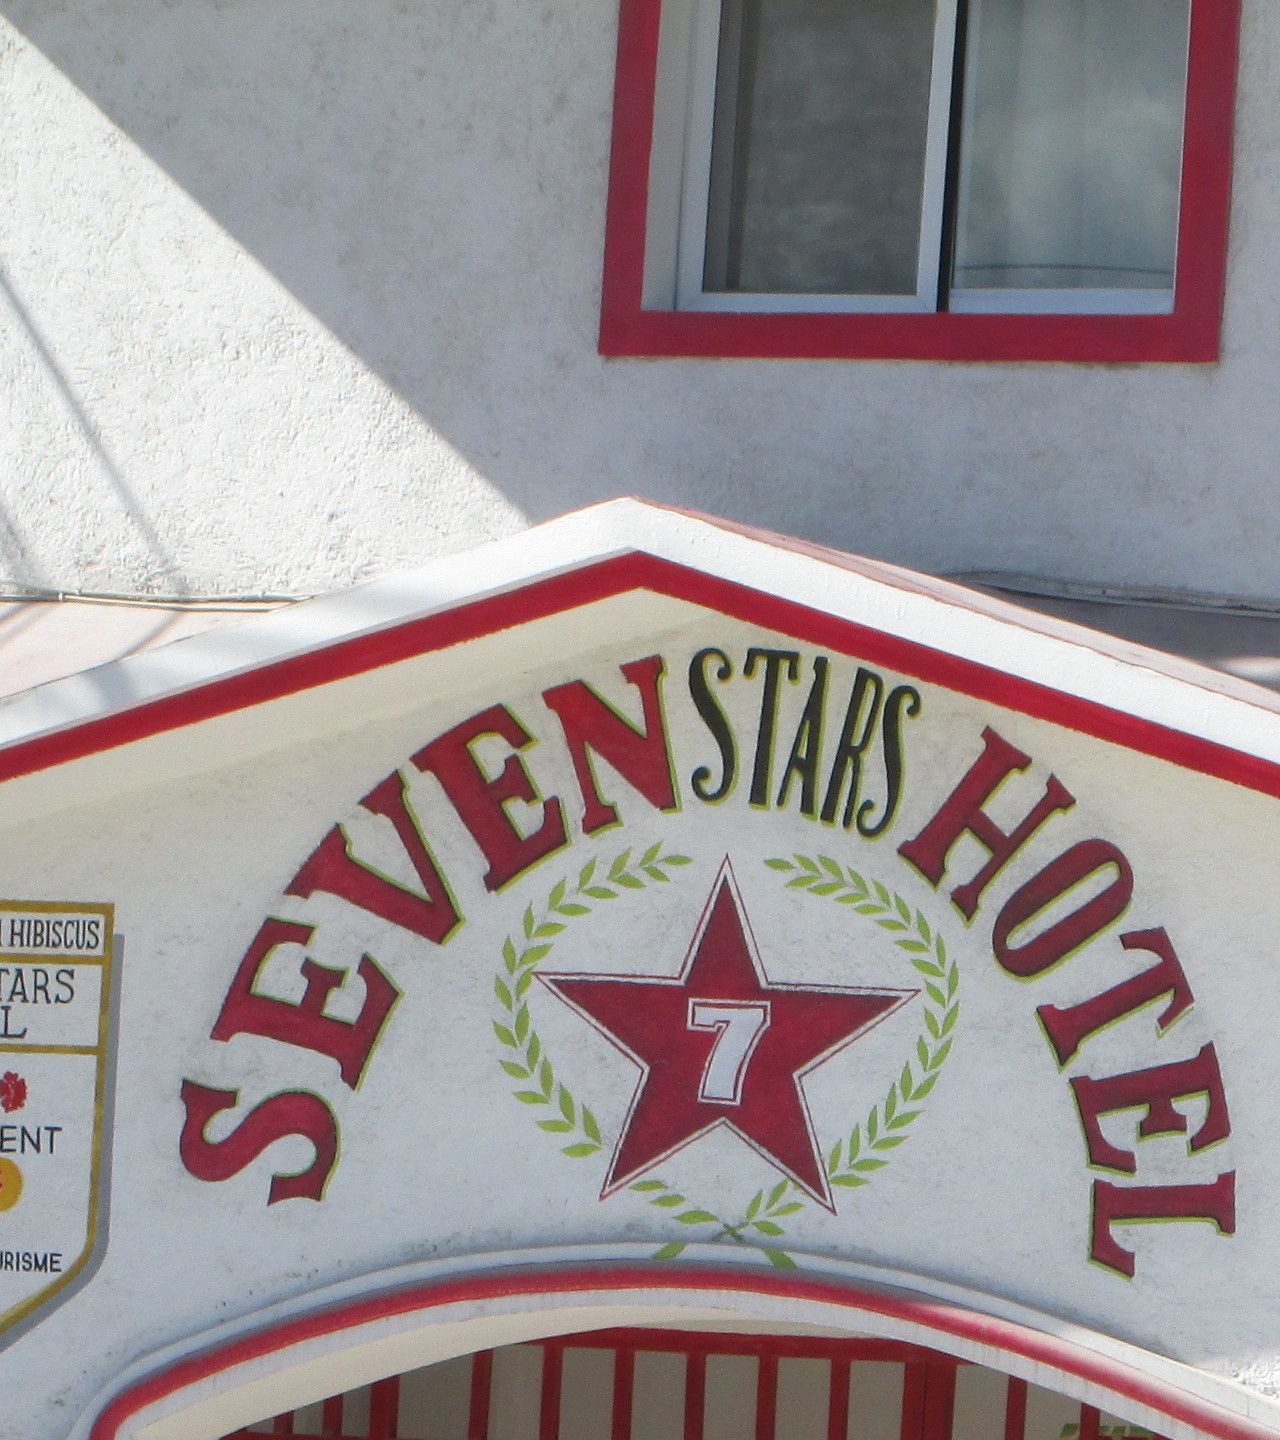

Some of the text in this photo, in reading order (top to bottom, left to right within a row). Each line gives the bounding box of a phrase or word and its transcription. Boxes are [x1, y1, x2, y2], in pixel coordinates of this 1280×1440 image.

[9, 917, 100, 949] HIBISCUS
[178, 647, 1238, 1280] SEVEN STARS HOTEL
[686, 999, 770, 1105] 7
